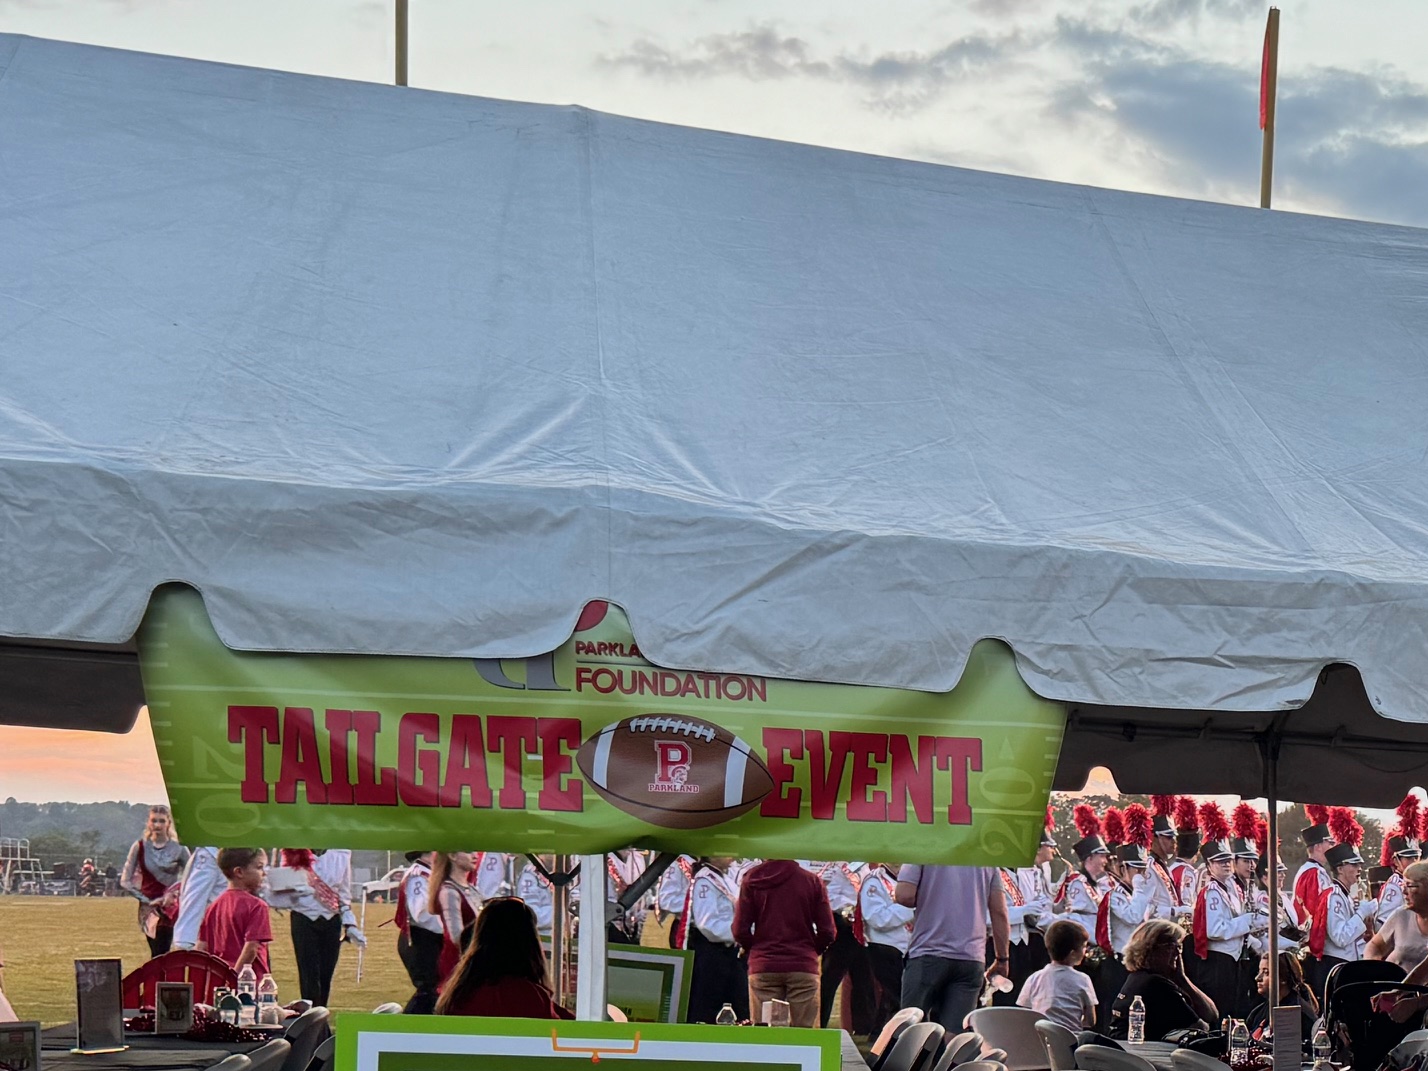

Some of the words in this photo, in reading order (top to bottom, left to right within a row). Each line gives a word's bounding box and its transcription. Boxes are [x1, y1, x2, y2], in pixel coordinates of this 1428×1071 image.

[575, 640, 643, 658] PARKLA
[575, 667, 767, 702] FOUNDATION
[228, 705, 584, 812] TAILGATE
[760, 727, 983, 825] EVENT
[648, 783, 699, 794] PARKLAND
